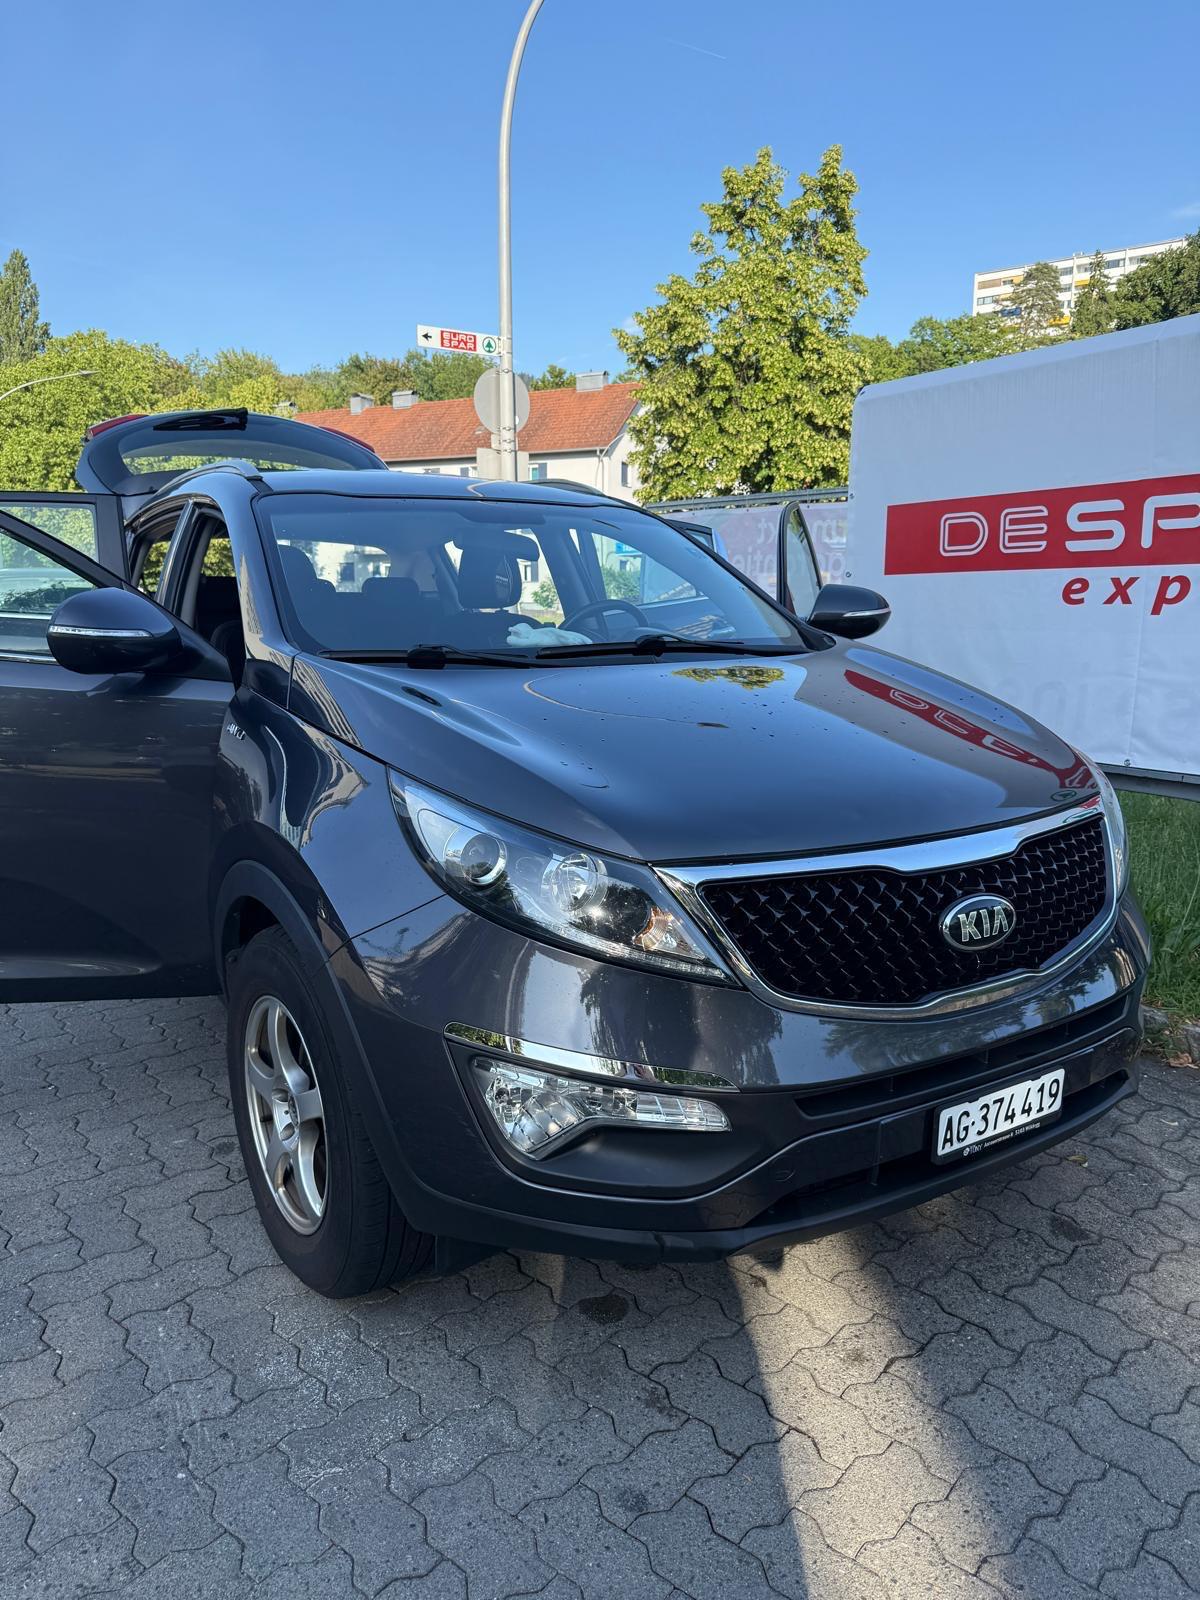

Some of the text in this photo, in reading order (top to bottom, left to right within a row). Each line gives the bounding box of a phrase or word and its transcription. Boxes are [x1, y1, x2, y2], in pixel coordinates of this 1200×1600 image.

[443, 332, 475, 342] EURO
[443, 340, 475, 350] SPAR
[940, 492, 1200, 556] DESP
[1062, 576, 1191, 615] exp
[958, 906, 1009, 942] KIA
